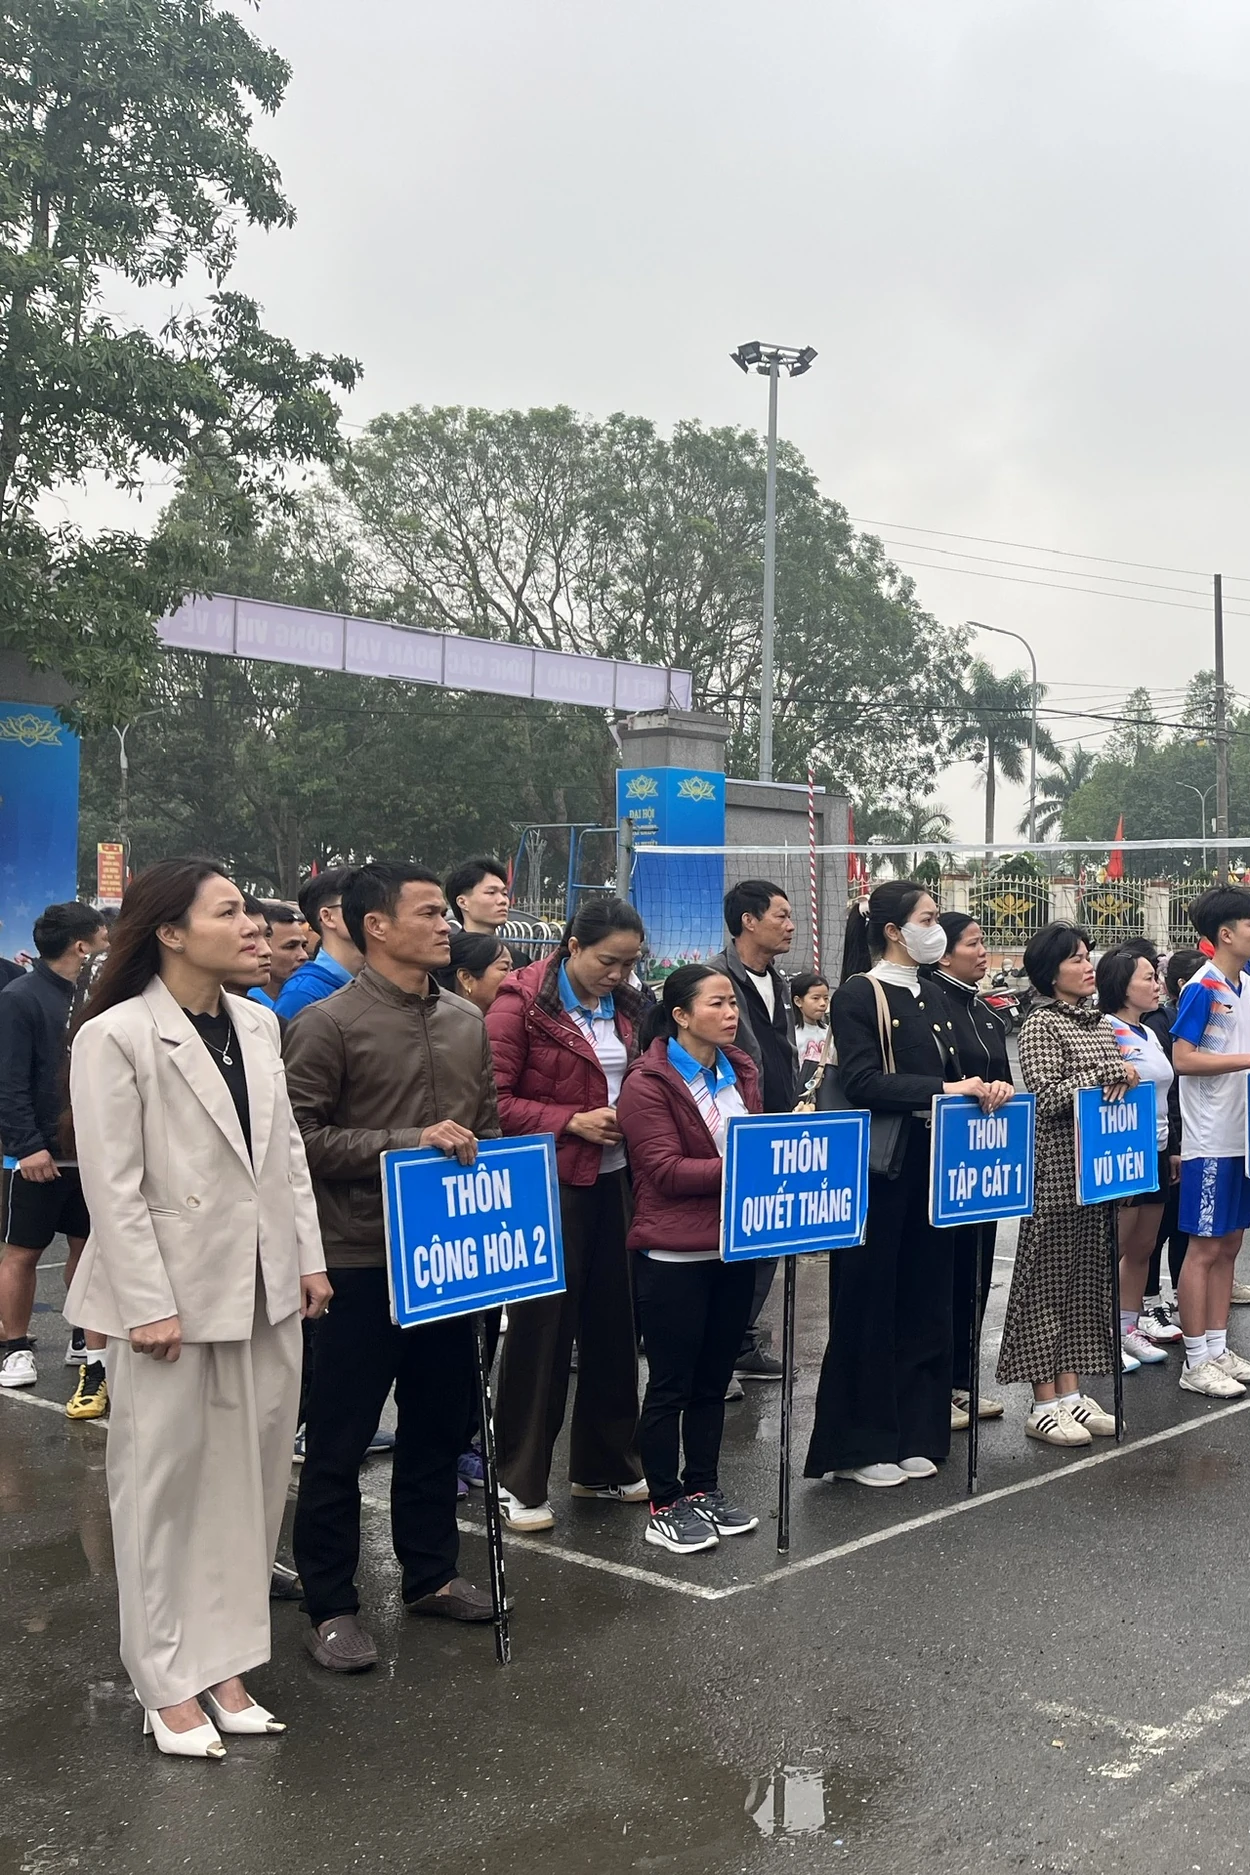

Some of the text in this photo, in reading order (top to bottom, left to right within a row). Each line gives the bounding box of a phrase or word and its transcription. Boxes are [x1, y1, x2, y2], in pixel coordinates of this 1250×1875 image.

[967, 1111, 1009, 1151] THÔN
[1098, 1097, 1138, 1135] THÔN
[770, 1130, 829, 1176] THÔN
[1093, 1146, 1144, 1186] VŨ YÊN
[442, 1164, 513, 1218] THÔN
[948, 1156, 1022, 1204] TẬP CÁT 1
[740, 1177, 852, 1237] QUYẾT THẮNG
[413, 1220, 548, 1296] CỘNG HÒA 2
